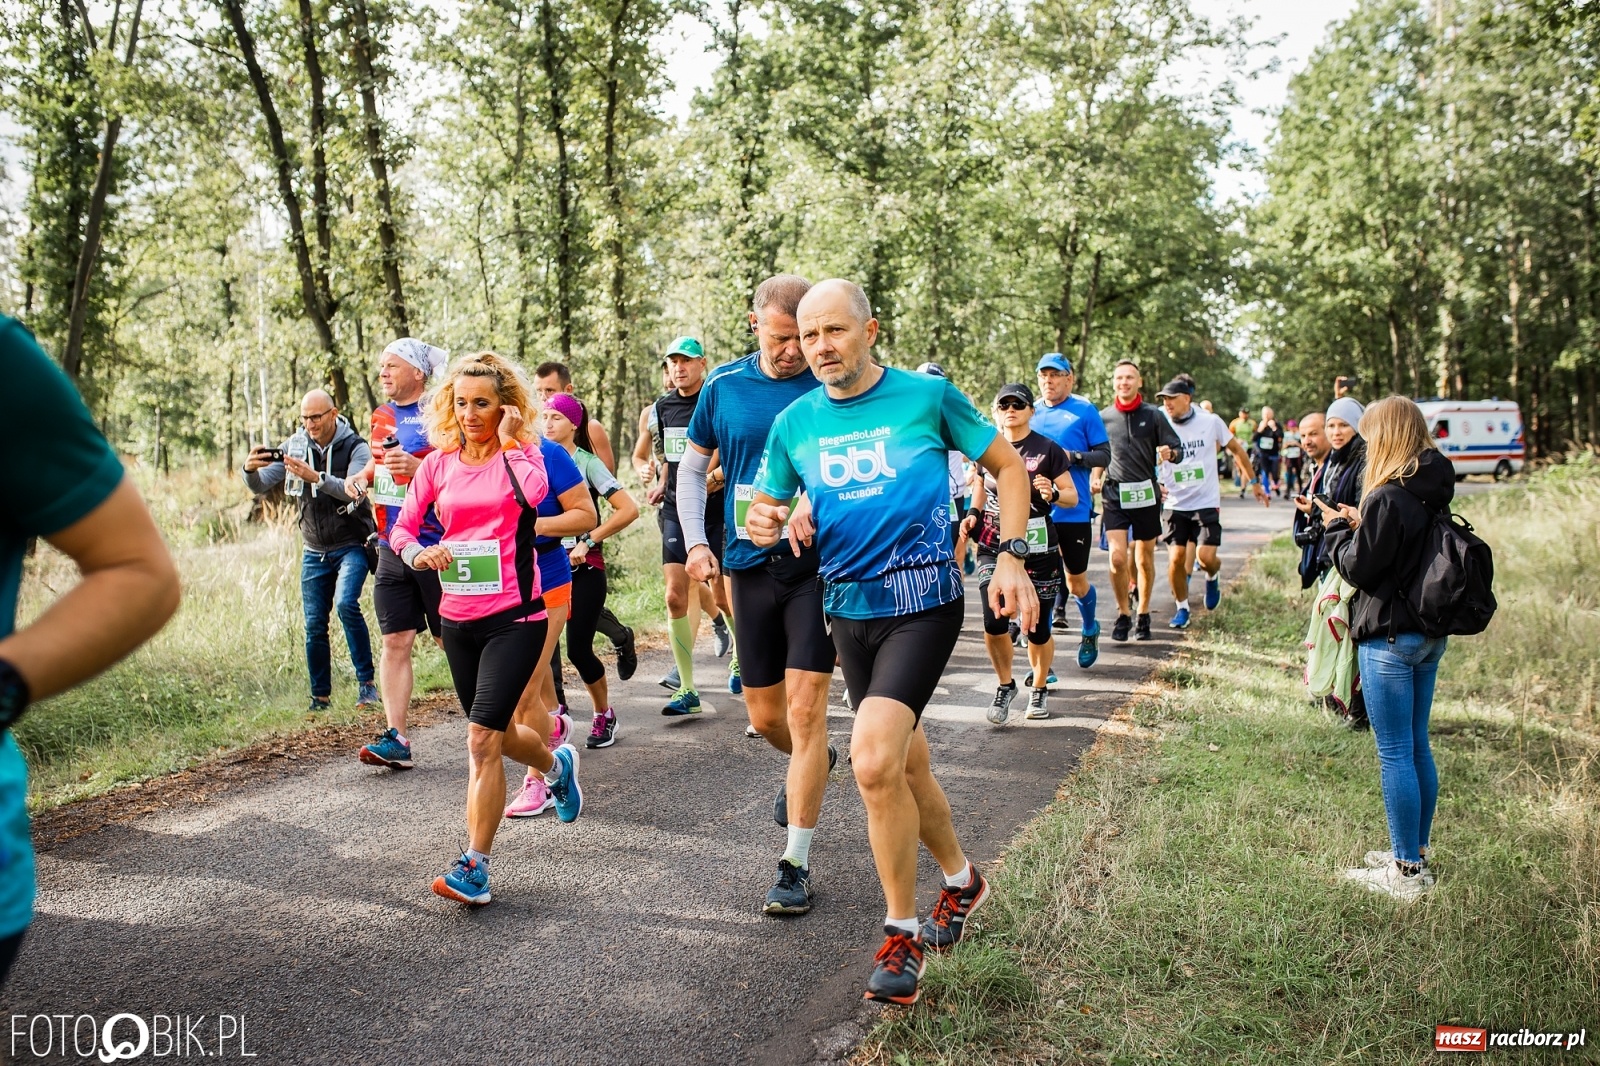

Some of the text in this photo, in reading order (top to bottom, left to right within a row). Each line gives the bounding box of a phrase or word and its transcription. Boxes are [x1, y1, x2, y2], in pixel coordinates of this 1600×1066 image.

[671, 438, 688, 453] 16
[1187, 440, 1205, 449] HUTA
[820, 441, 897, 488] bbl
[1181, 470, 1197, 481] 32
[377, 477, 399, 496] 104
[838, 486, 884, 501] RACIBÓRZ
[1129, 490, 1147, 502] 39
[1025, 529, 1039, 544] 2
[457, 560, 471, 581] 5
